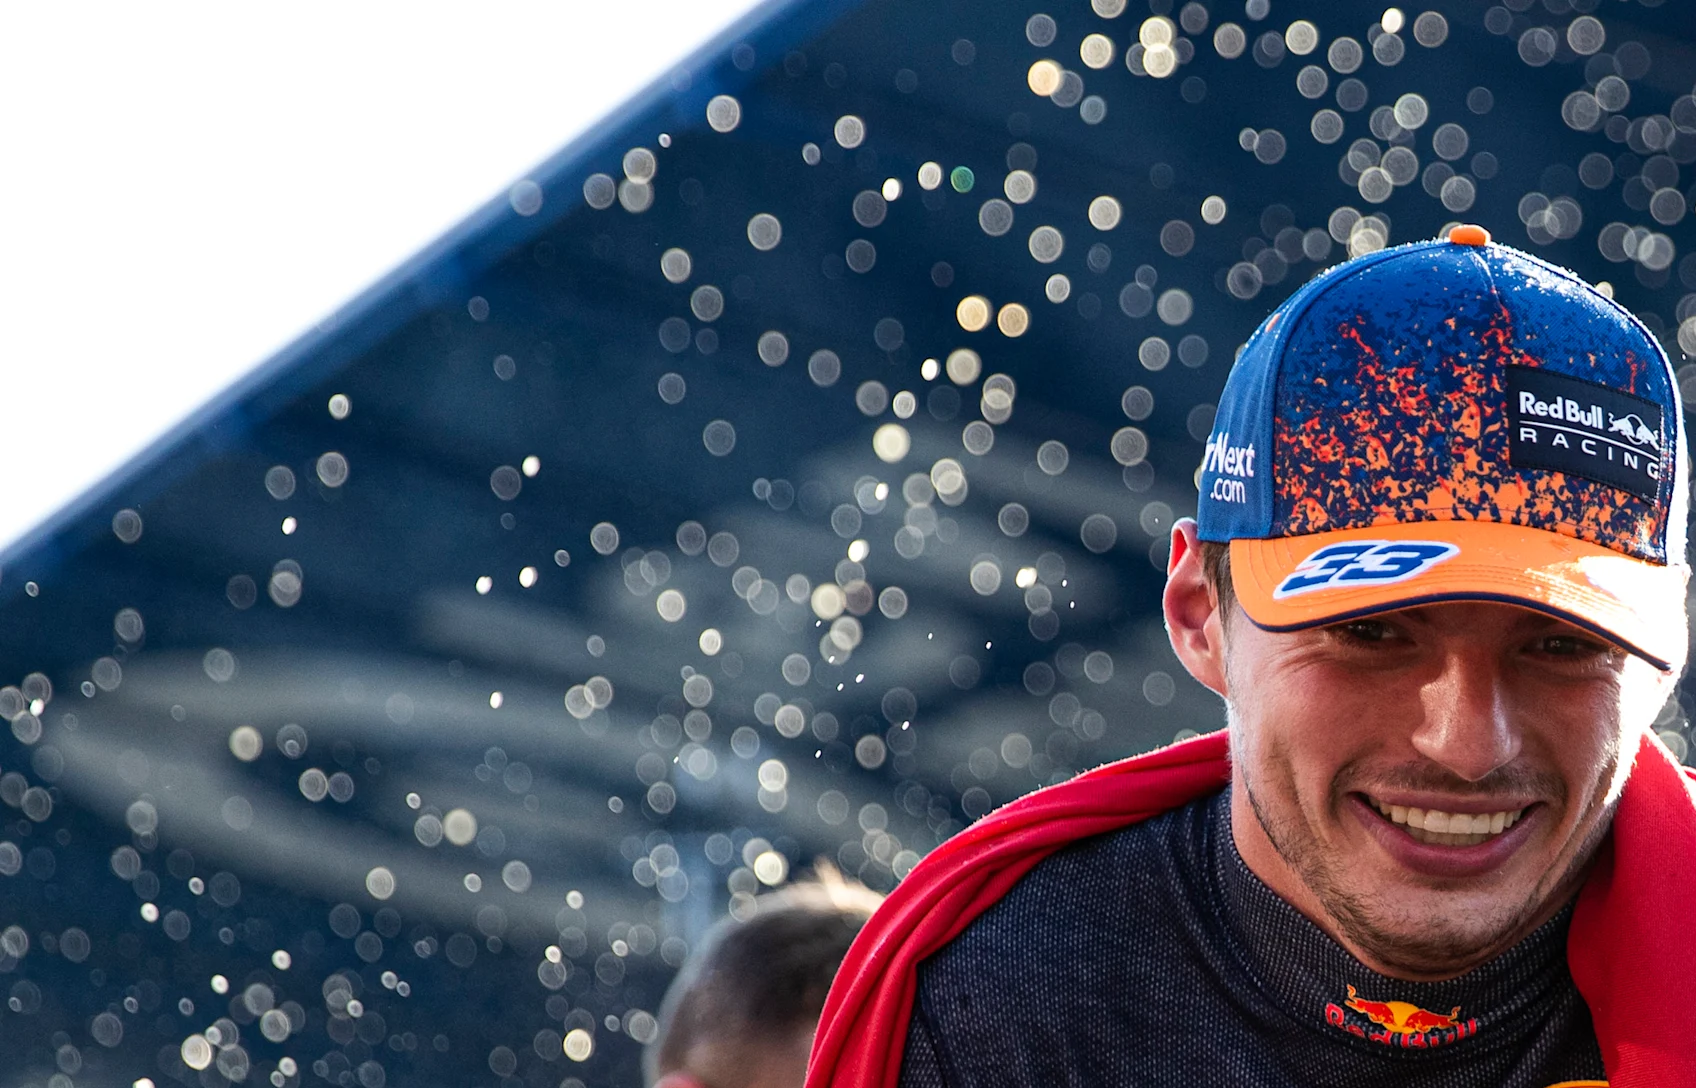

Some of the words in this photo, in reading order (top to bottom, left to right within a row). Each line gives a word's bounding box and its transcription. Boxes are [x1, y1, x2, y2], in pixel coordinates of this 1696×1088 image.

[1519, 427, 1660, 480] RACING
[1210, 477, 1246, 504] .com
[1273, 540, 1461, 600] 33
